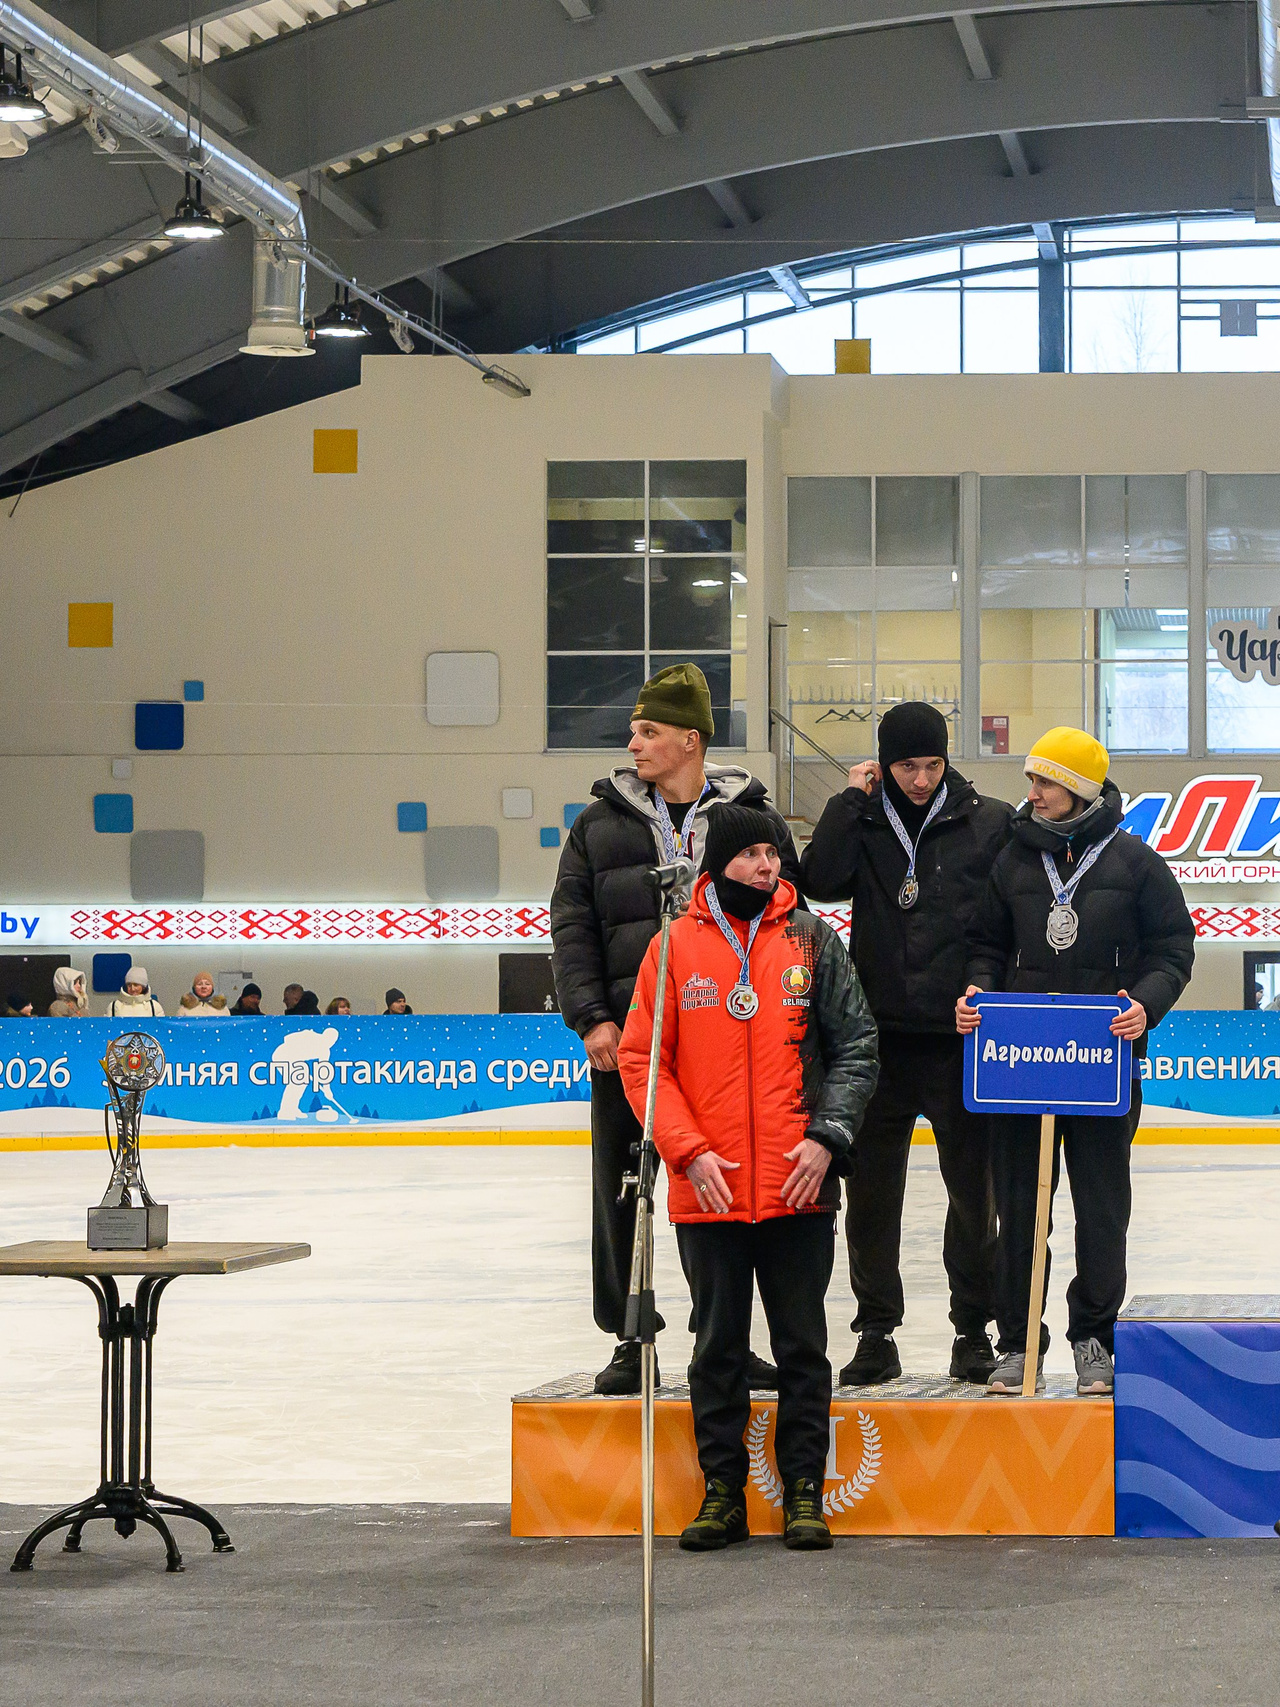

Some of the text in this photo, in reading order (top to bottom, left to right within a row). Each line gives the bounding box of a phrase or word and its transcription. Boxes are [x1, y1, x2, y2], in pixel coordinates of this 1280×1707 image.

[982, 1038, 1114, 1069] Агрохолдинг
[0, 1056, 71, 1089] 026
[249, 1059, 477, 1092] спартакиада
[487, 1058, 592, 1091] среди
